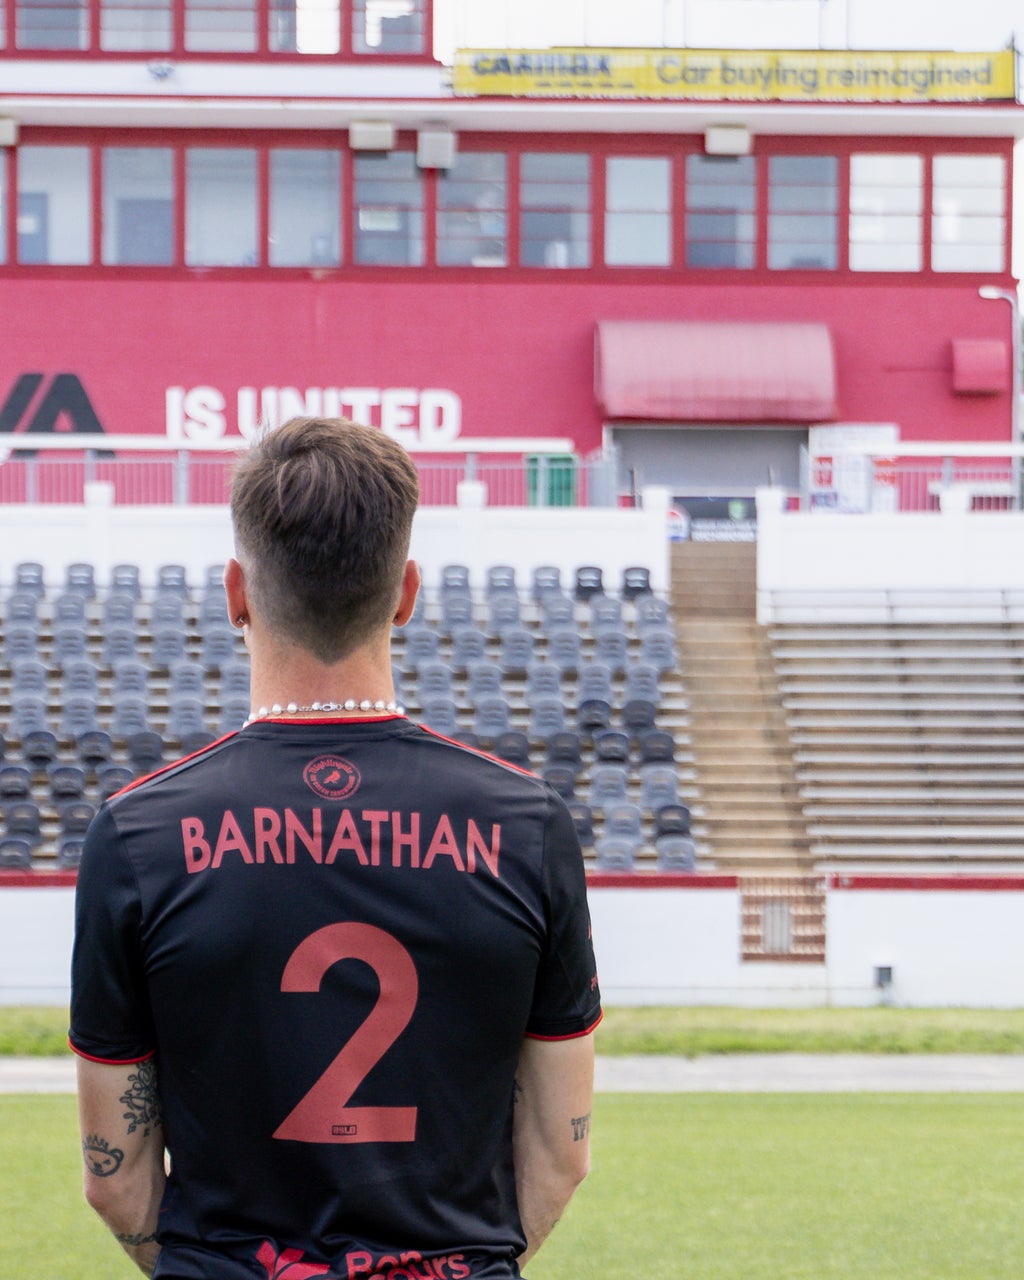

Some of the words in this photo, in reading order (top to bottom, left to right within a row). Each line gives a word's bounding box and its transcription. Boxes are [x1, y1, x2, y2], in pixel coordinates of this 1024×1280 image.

[656, 57, 709, 84] Car
[721, 58, 818, 92] buying
[826, 60, 992, 92] reimagined
[165, 385, 226, 441] IS
[237, 386, 463, 443] UNITED
[180, 808, 501, 878] BARNATHAN
[272, 921, 419, 1144] 2
